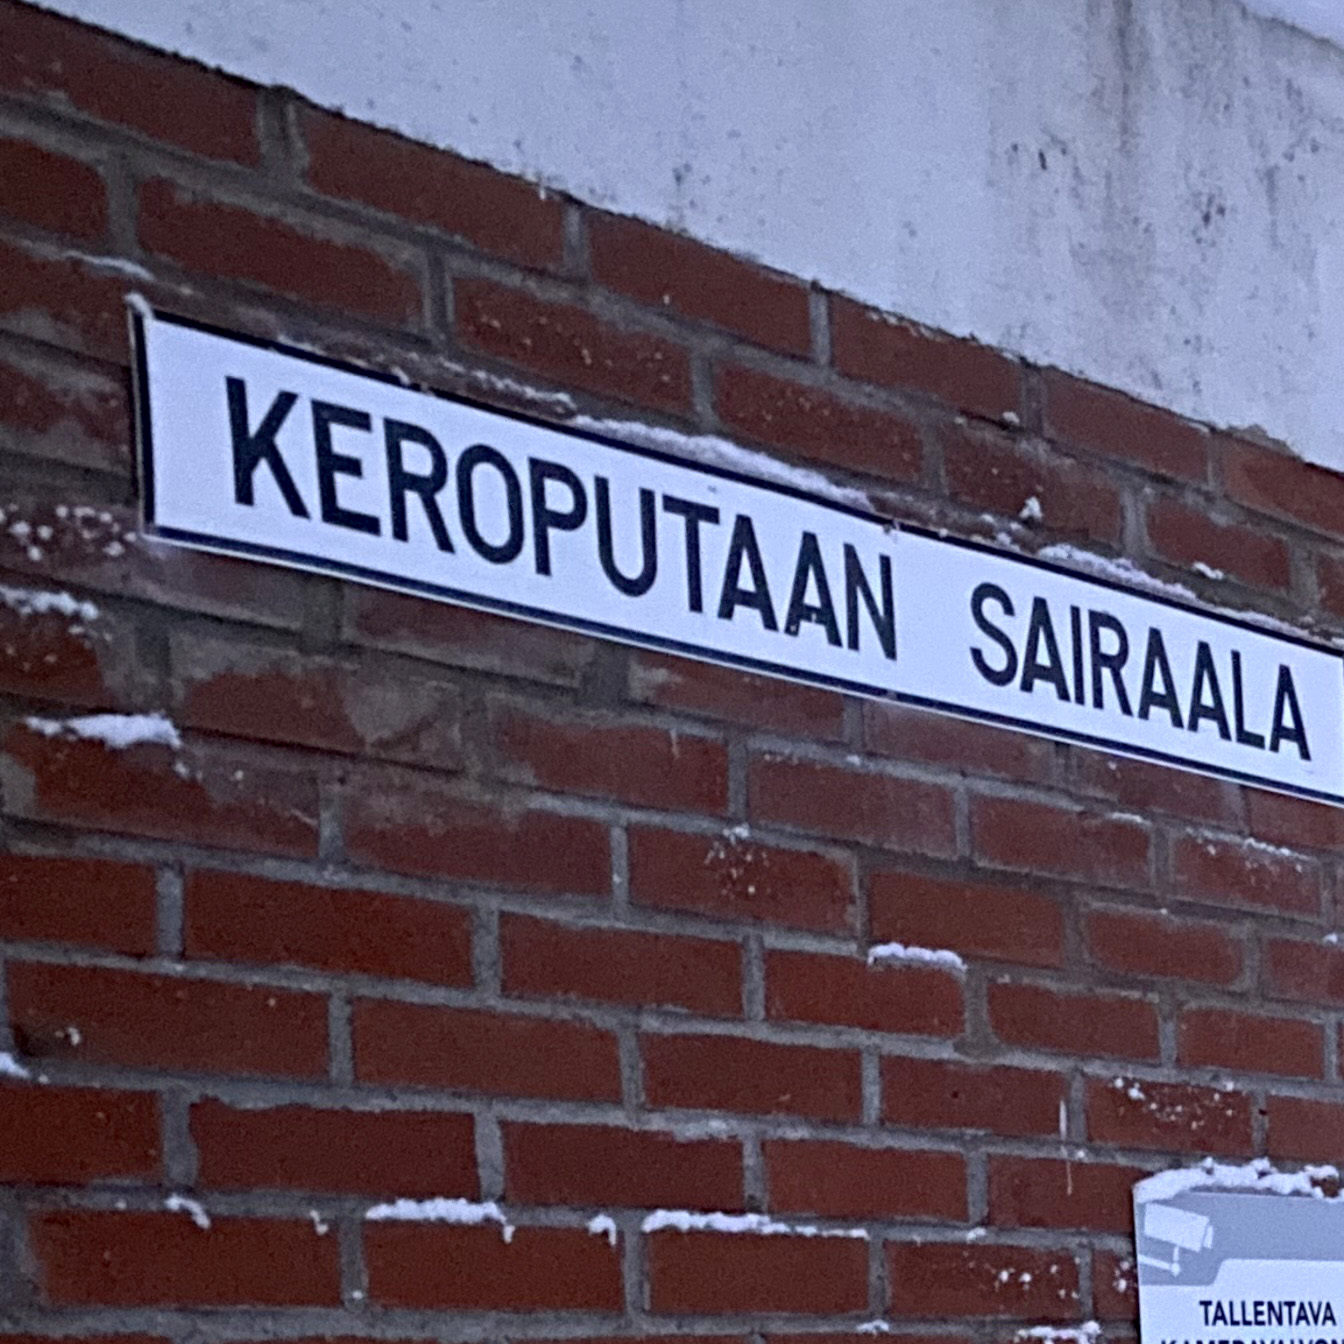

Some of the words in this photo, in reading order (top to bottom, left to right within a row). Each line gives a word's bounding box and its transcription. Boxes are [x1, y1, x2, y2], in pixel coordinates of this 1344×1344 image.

[225, 376, 898, 662] KEROPUTAAN
[969, 583, 1313, 761] SAIRAALA
[1199, 1300, 1337, 1326] TALLENTAVA
